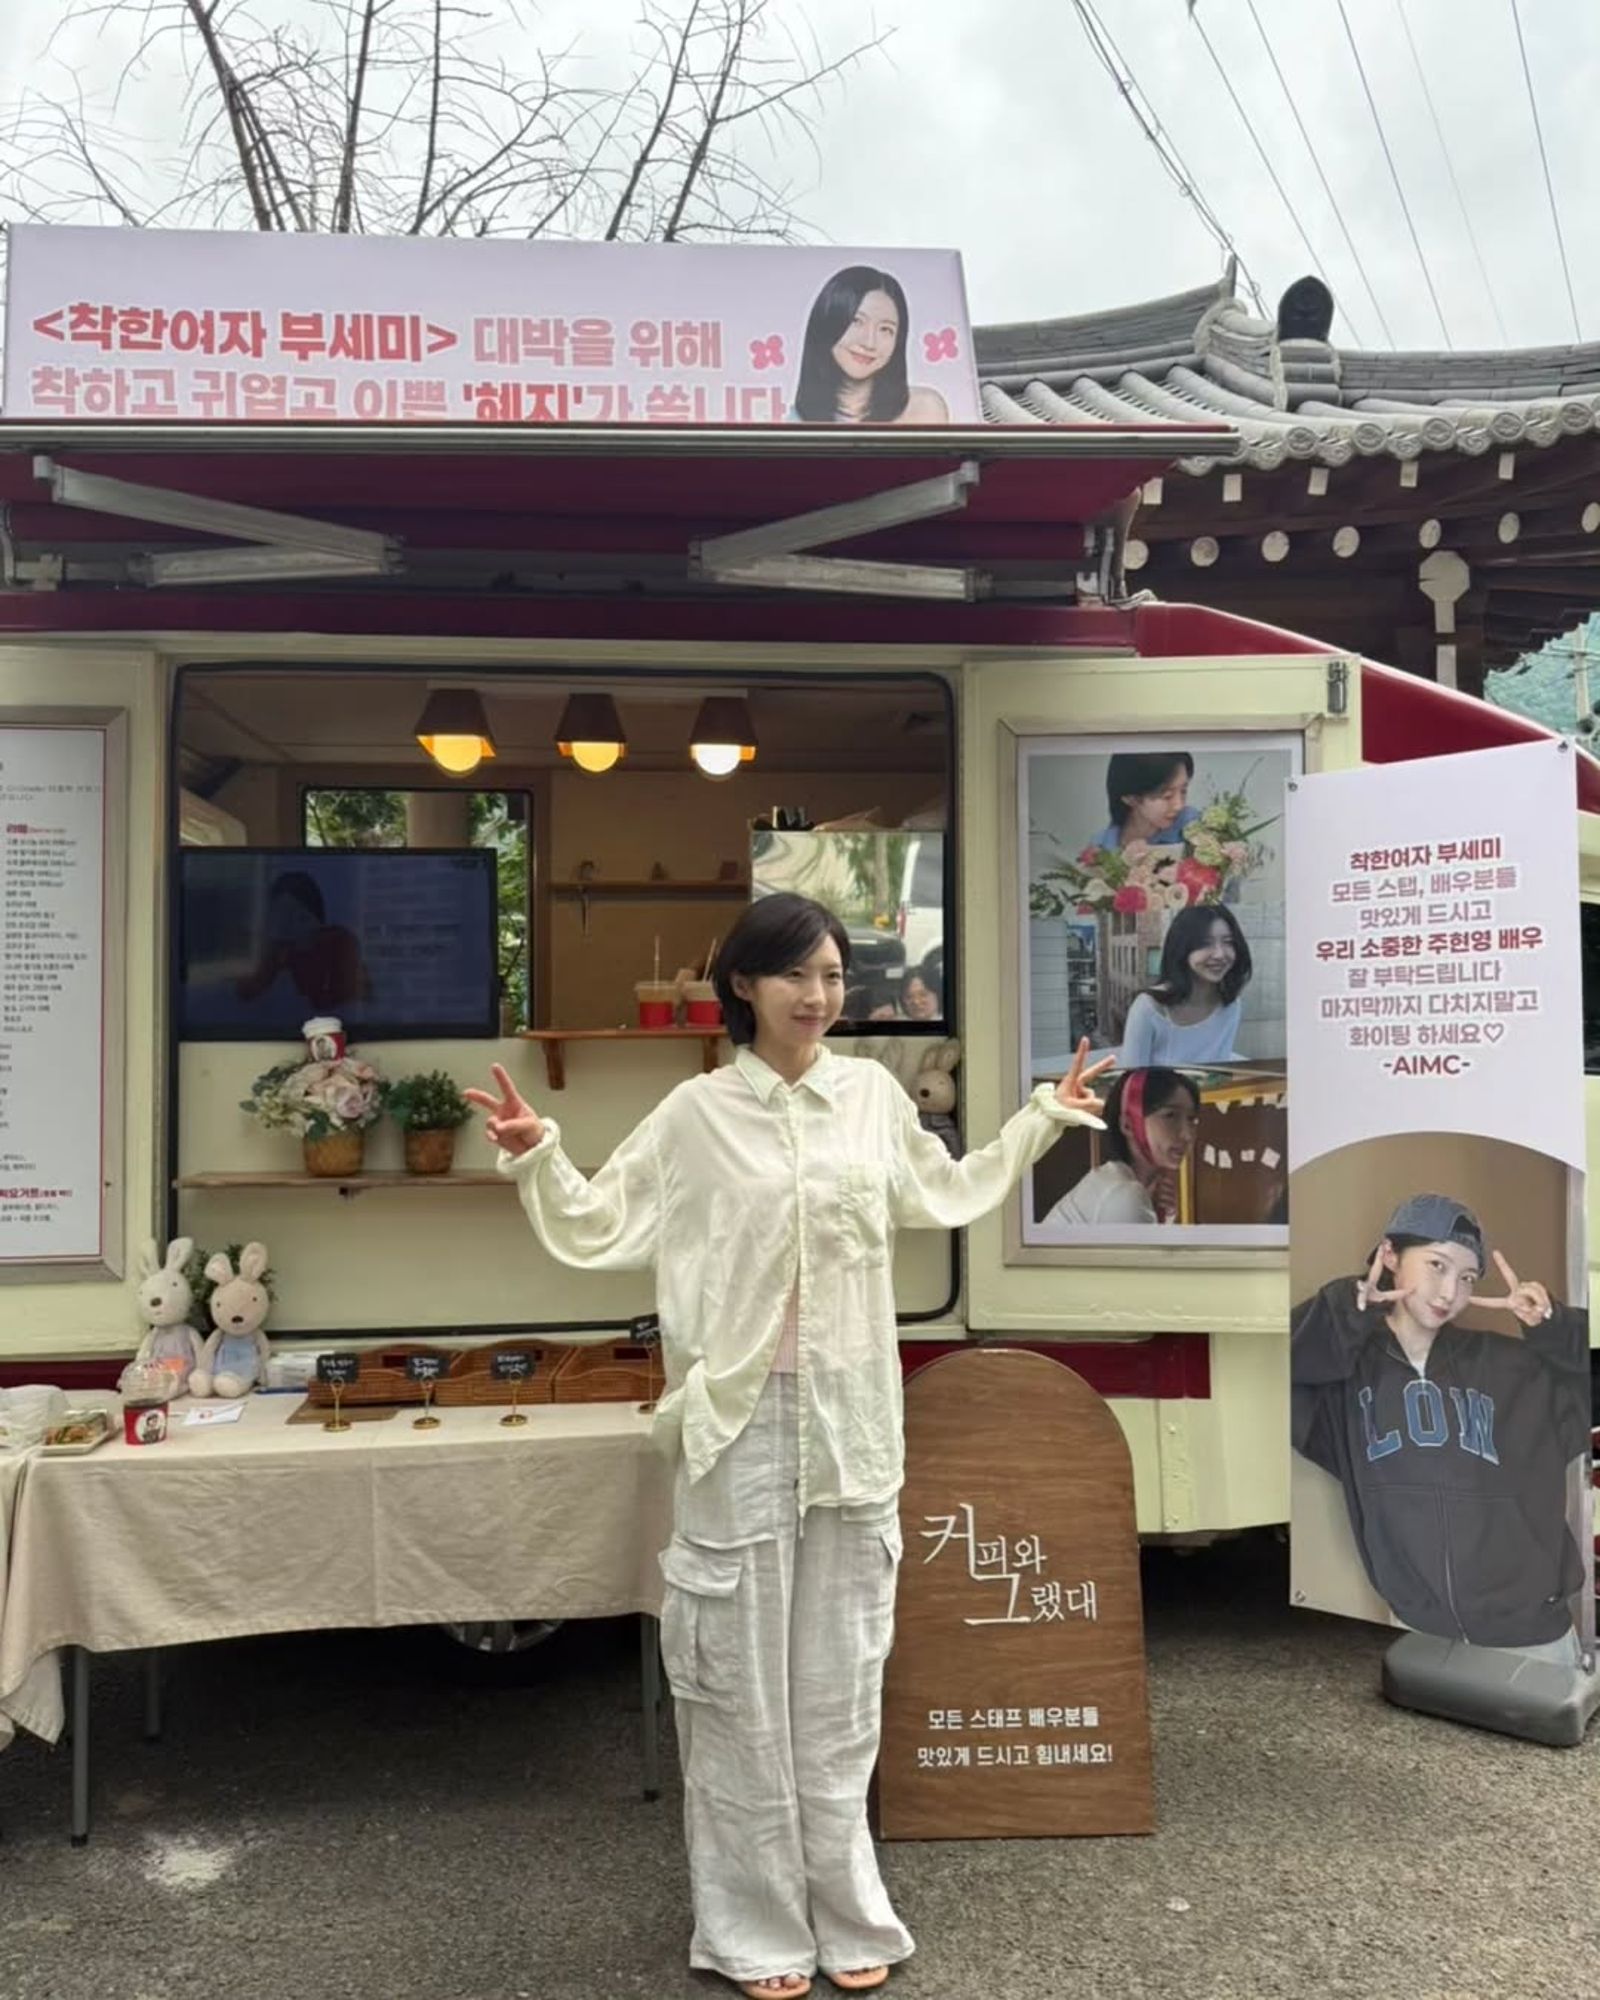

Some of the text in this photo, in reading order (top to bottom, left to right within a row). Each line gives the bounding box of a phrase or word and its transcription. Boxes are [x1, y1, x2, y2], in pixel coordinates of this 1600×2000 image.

[33, 302, 721, 369] <착한여자 부세미> 대박을 위해
[32, 366, 178, 415] 착하고
[192, 371, 337, 418] 귀엽고
[353, 379, 447, 420] 이쁜
[463, 382, 633, 421] '혜지'가
[1350, 837, 1501, 872] 착한여자 부세미
[1332, 867, 1516, 902] 모든 스탭, 배우분들
[1360, 900, 1492, 929] 맛있게 드시고
[1316, 939, 1355, 962] 우리
[1360, 935, 1423, 958] 소중한
[1499, 926, 1543, 949] 배우
[1349, 960, 1501, 988] 잘 부탁드립니다
[1321, 990, 1538, 1018] 마지막까지 다치지말고
[1350, 1024, 1411, 1047] 화이팅
[1384, 1055, 1470, 1076] -AIMC-
[1358, 1379, 1500, 1467] LOW
[920, 1502, 1048, 1578] 커피와
[963, 1573, 1097, 1626] 그랬대
[928, 1706, 1099, 1730] 모든 스태프 배우분들
[917, 1743, 1113, 1768] 맛있게 드시고 힘내세요!
